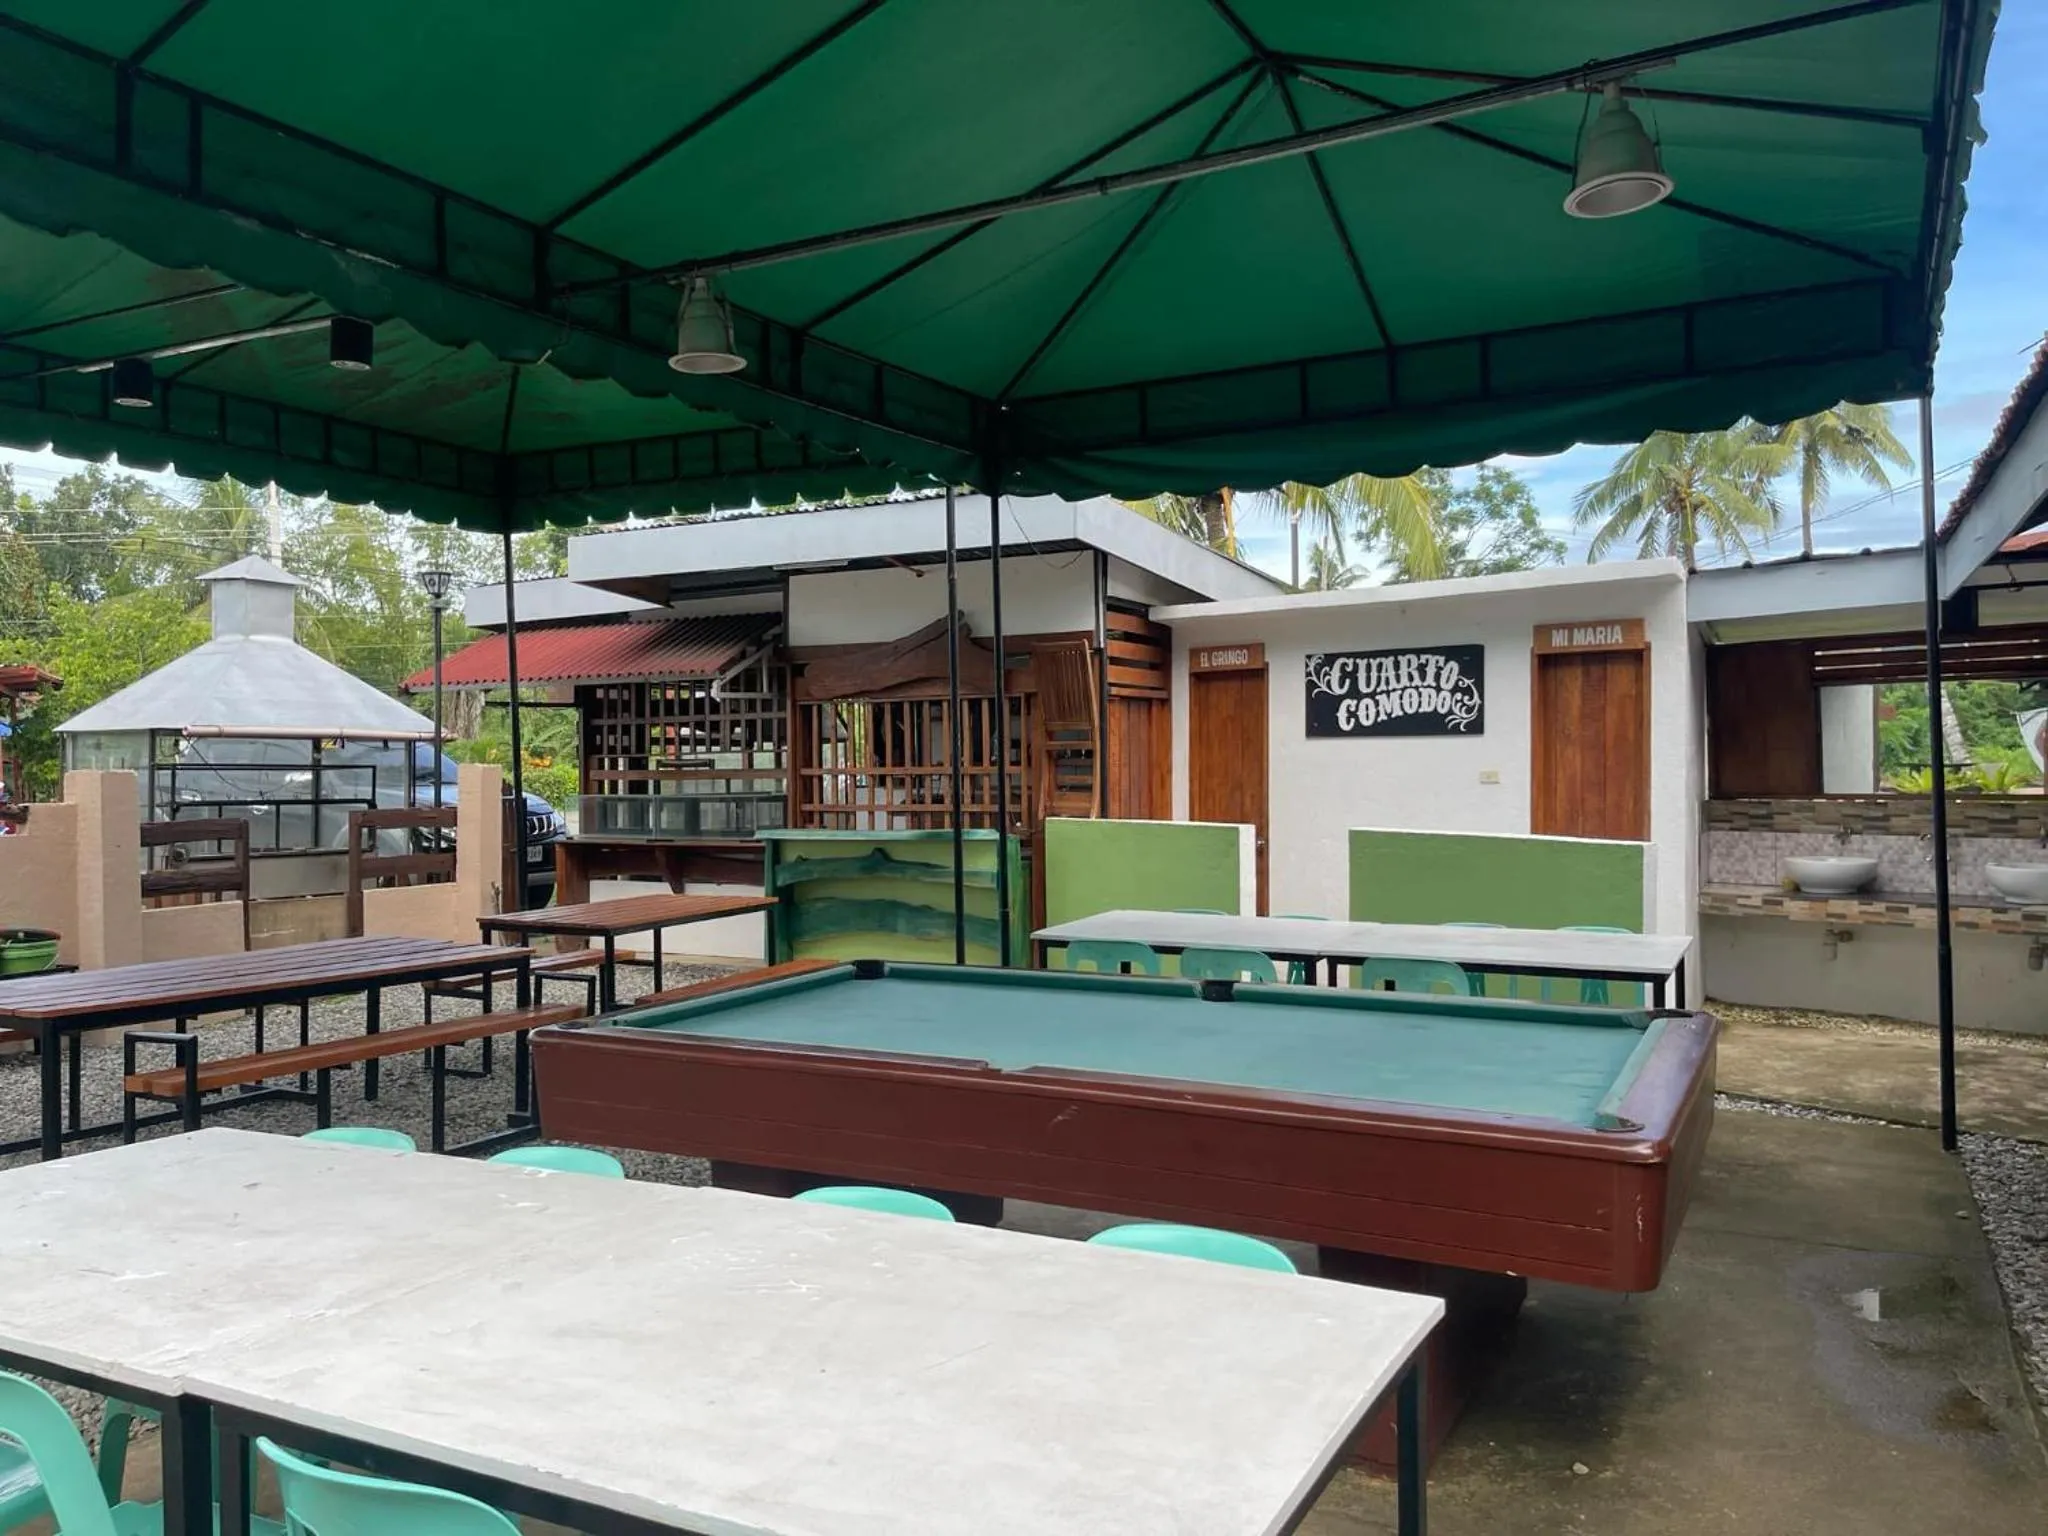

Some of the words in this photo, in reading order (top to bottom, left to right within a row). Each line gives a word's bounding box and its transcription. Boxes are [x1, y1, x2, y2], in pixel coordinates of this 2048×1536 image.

[1551, 628, 1568, 647] MI
[1573, 624, 1623, 646] MARIA
[1200, 651, 1209, 667] EL
[1212, 648, 1248, 667] GRINGO
[1330, 654, 1459, 695] CUARTO
[1337, 687, 1451, 731] COMODO
